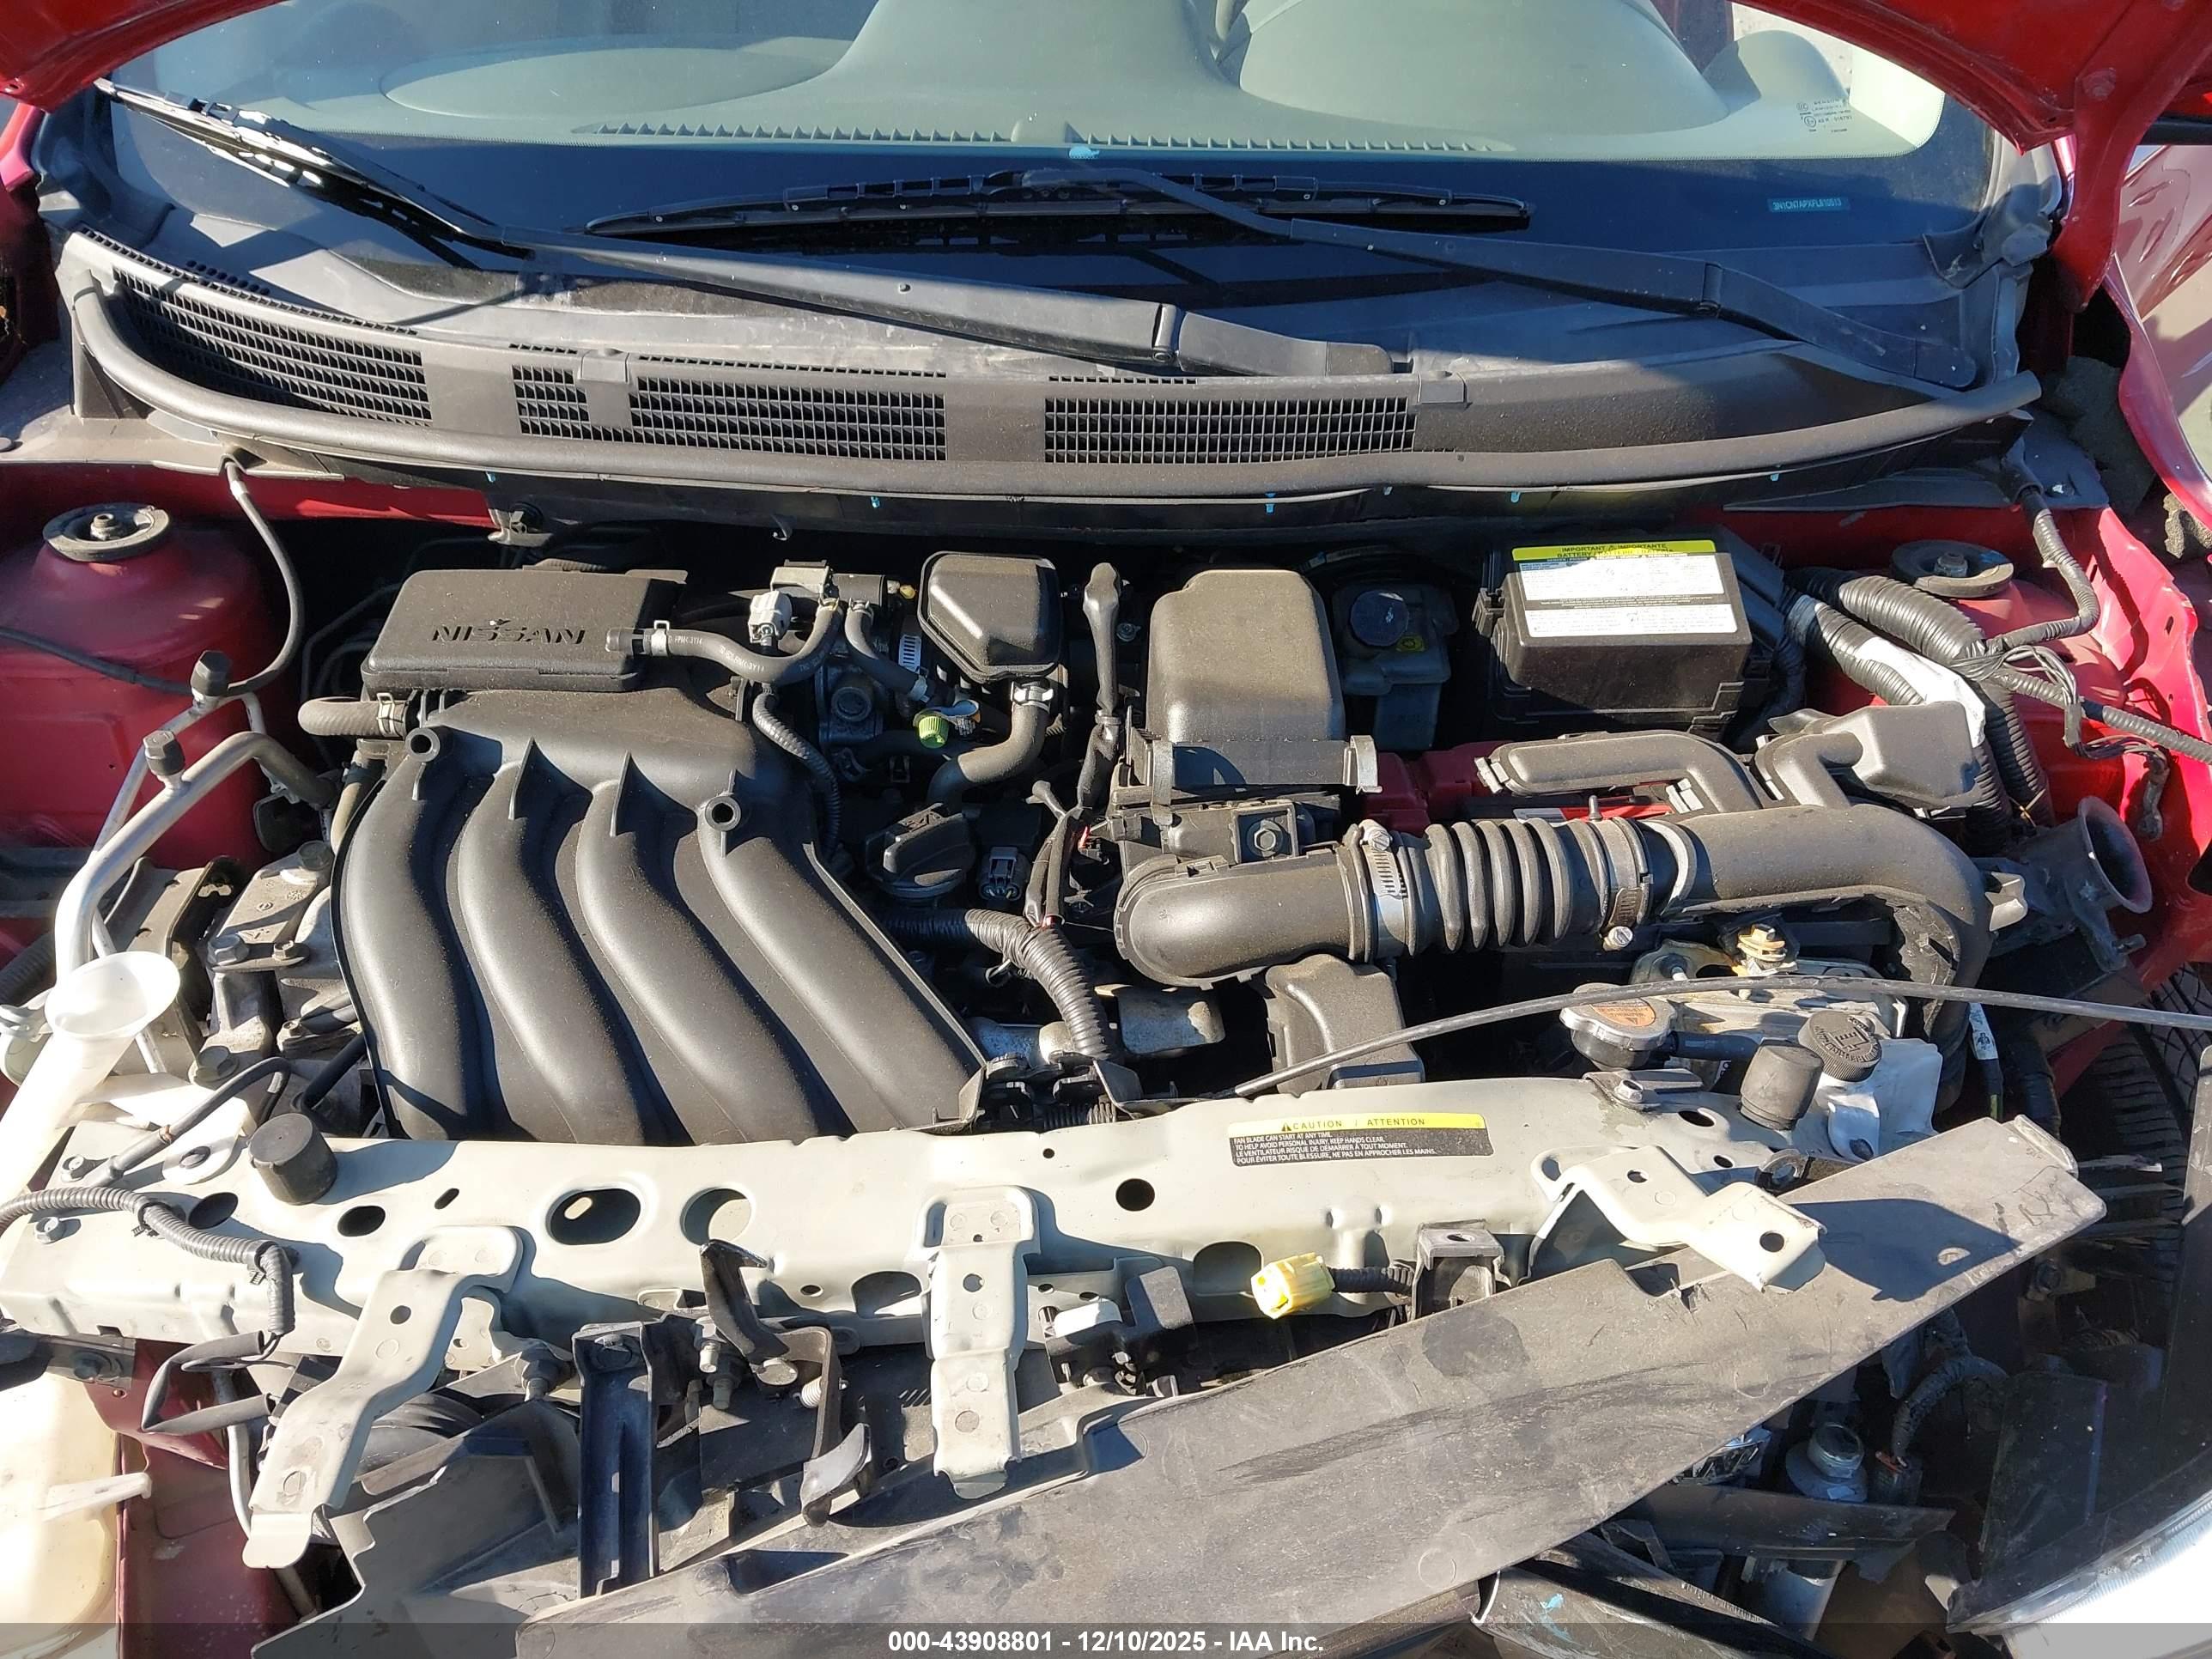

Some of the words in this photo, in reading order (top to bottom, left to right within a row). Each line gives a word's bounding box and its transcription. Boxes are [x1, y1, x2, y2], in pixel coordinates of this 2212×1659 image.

[432, 626, 586, 645] NISSAN
[1292, 1120, 1343, 1130] CAUTION
[1367, 1118, 1425, 1127] ATTENTION
[1243, 1147, 1286, 1157] VENTILATEUR
[1255, 1154, 1278, 1163] ÉVITER
